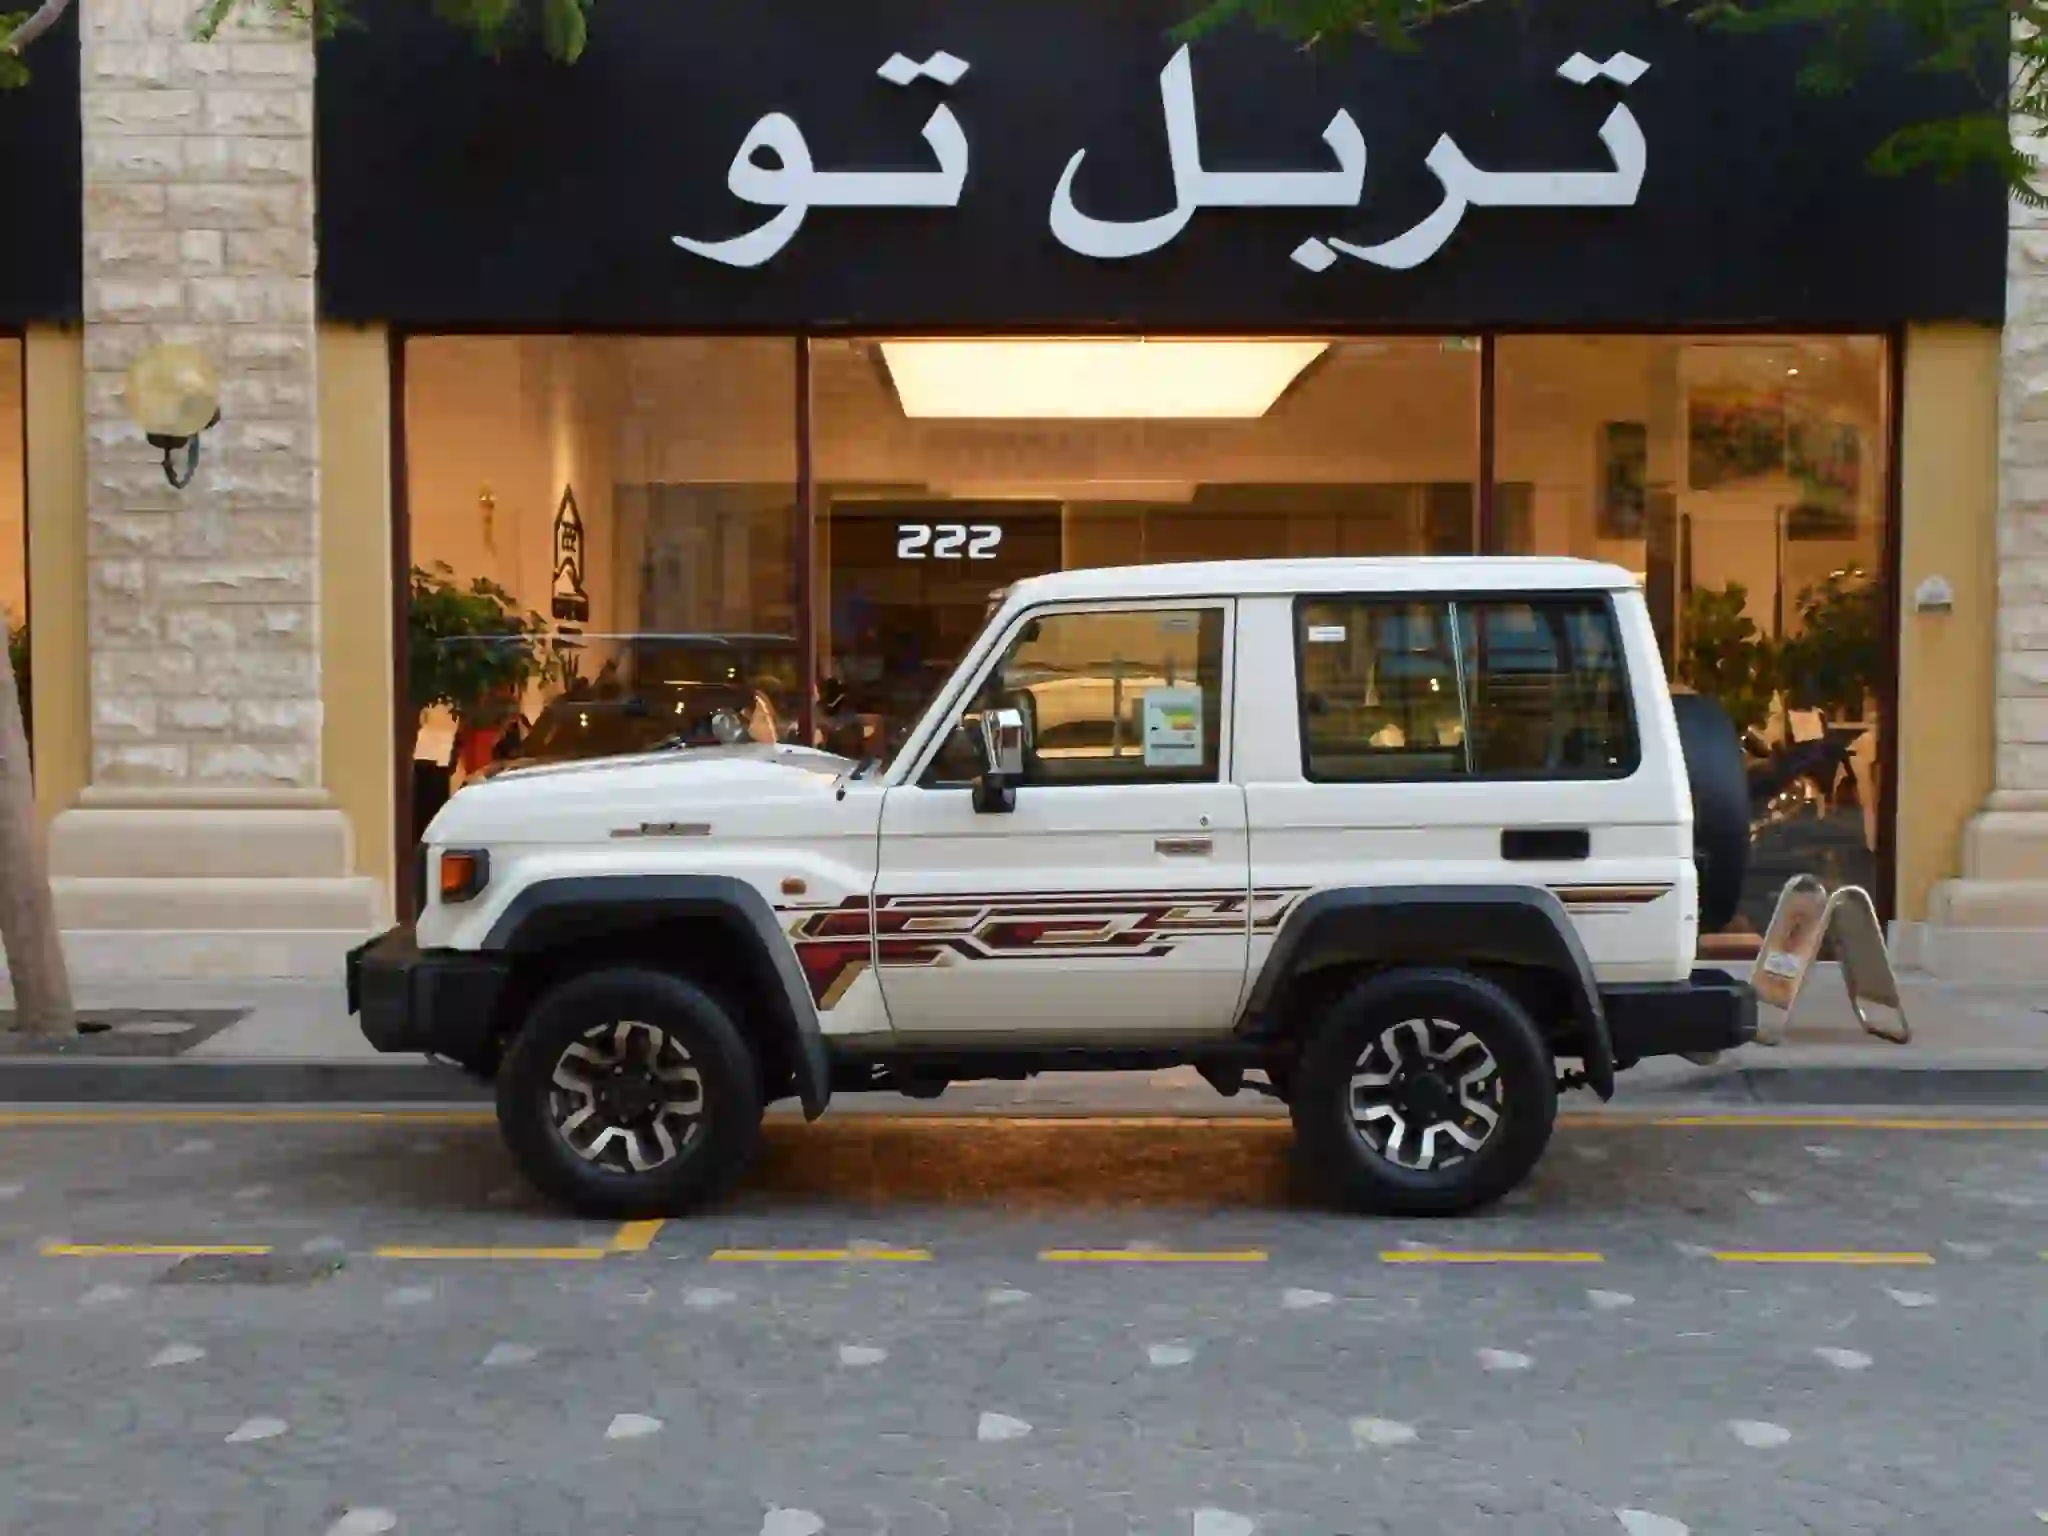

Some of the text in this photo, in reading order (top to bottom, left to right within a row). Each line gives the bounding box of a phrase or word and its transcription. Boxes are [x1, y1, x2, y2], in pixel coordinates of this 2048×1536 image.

[672, 43, 1651, 272] تربل تو
[897, 524, 1003, 560] 222
